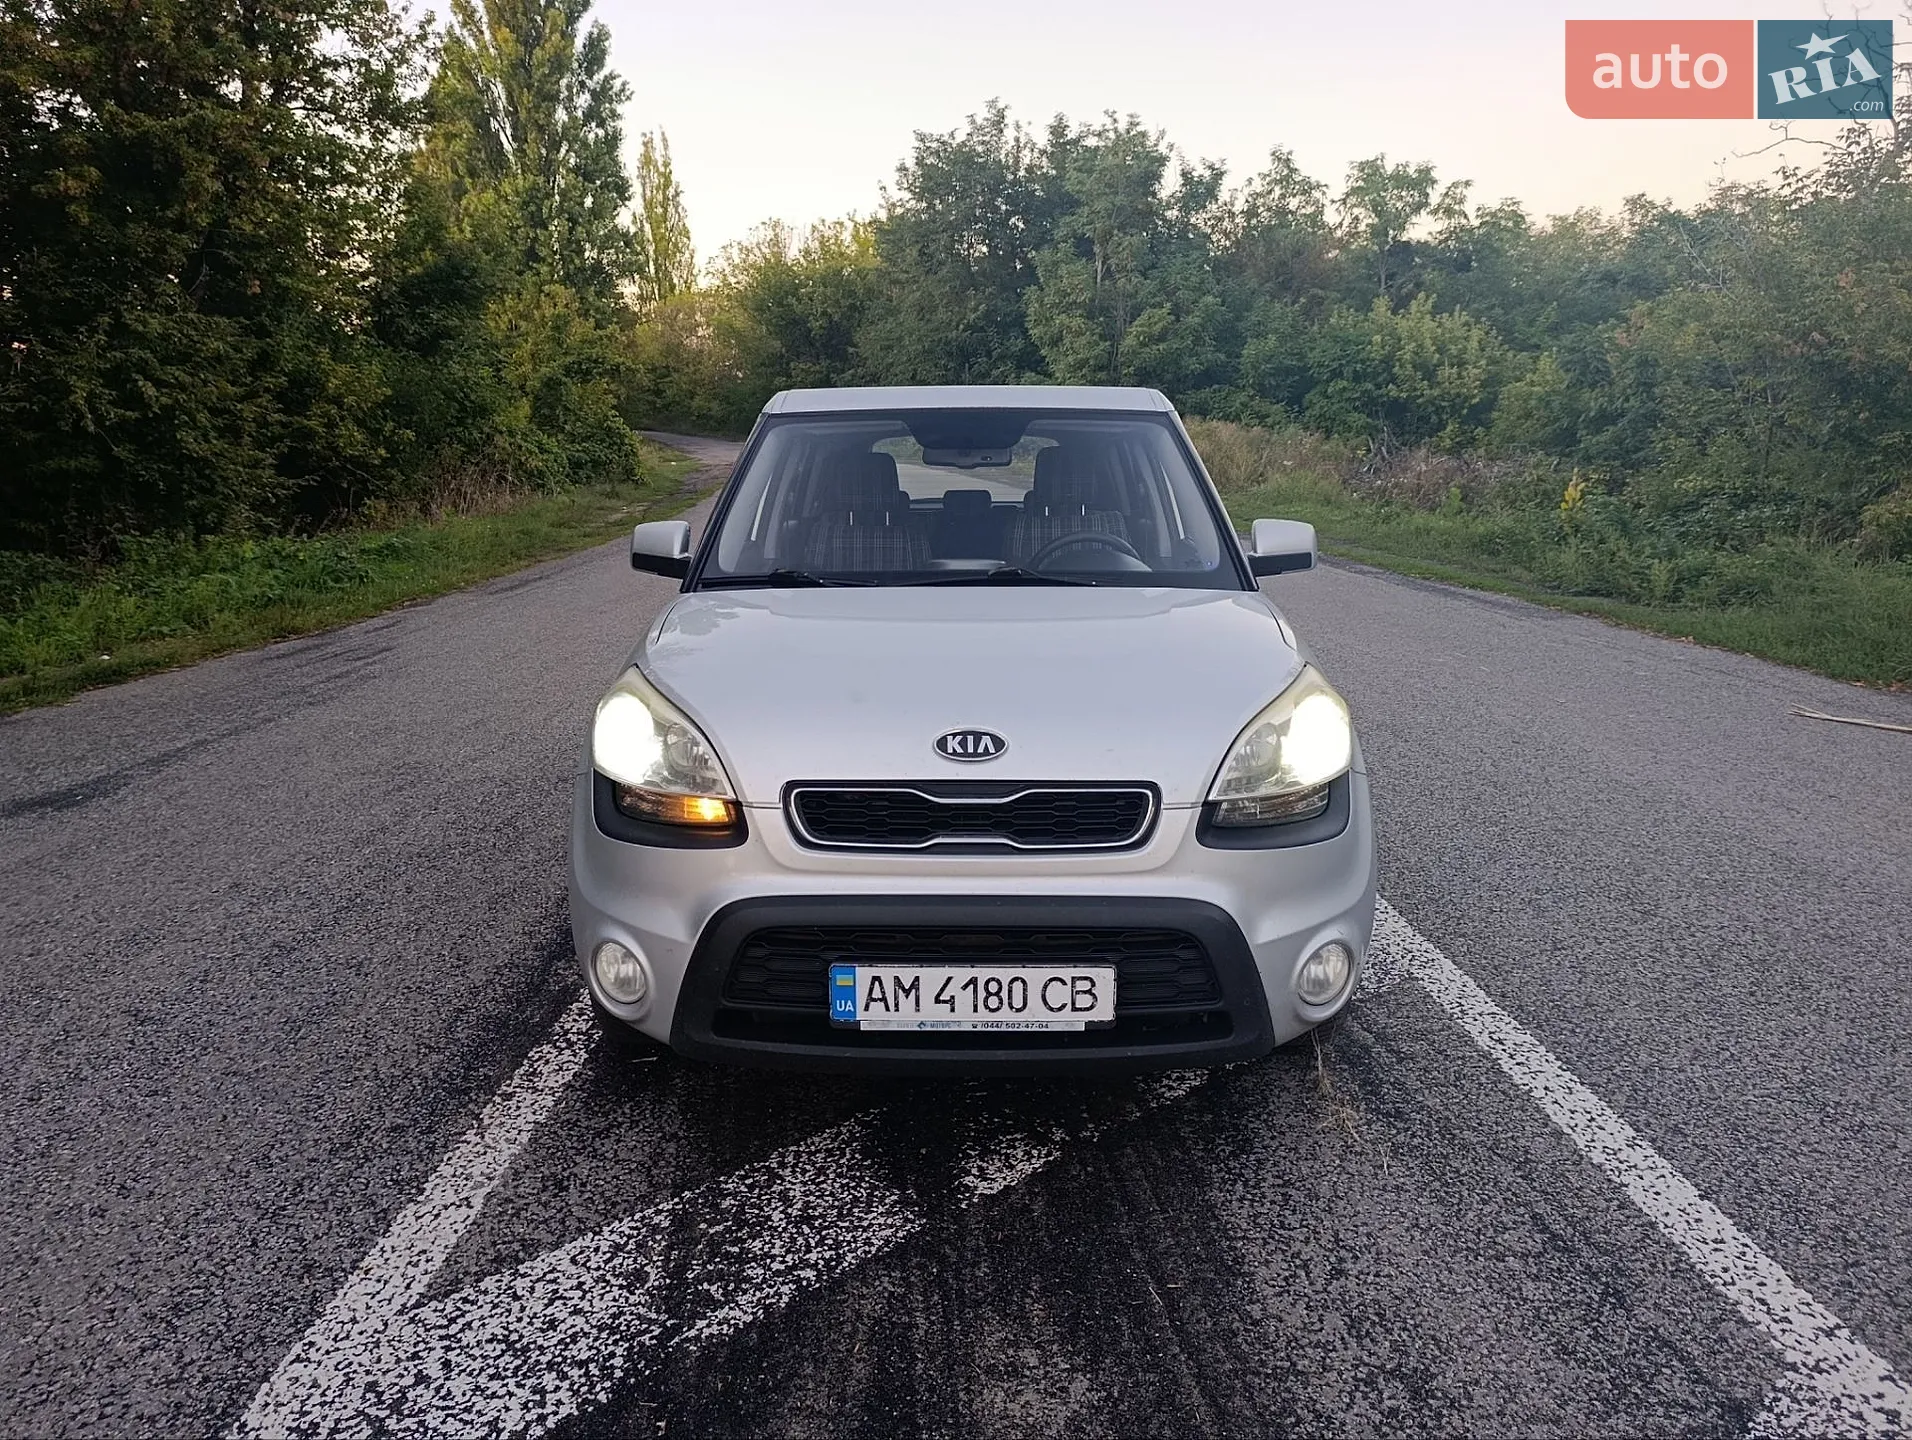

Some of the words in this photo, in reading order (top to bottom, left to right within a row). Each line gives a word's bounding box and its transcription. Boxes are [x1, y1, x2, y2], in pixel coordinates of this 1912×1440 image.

[946, 735, 996, 753] KIA
[863, 975, 920, 1013] AM
[934, 975, 1029, 1013] 4180
[1041, 976, 1098, 1013] CB
[836, 1000, 854, 1012] UA
